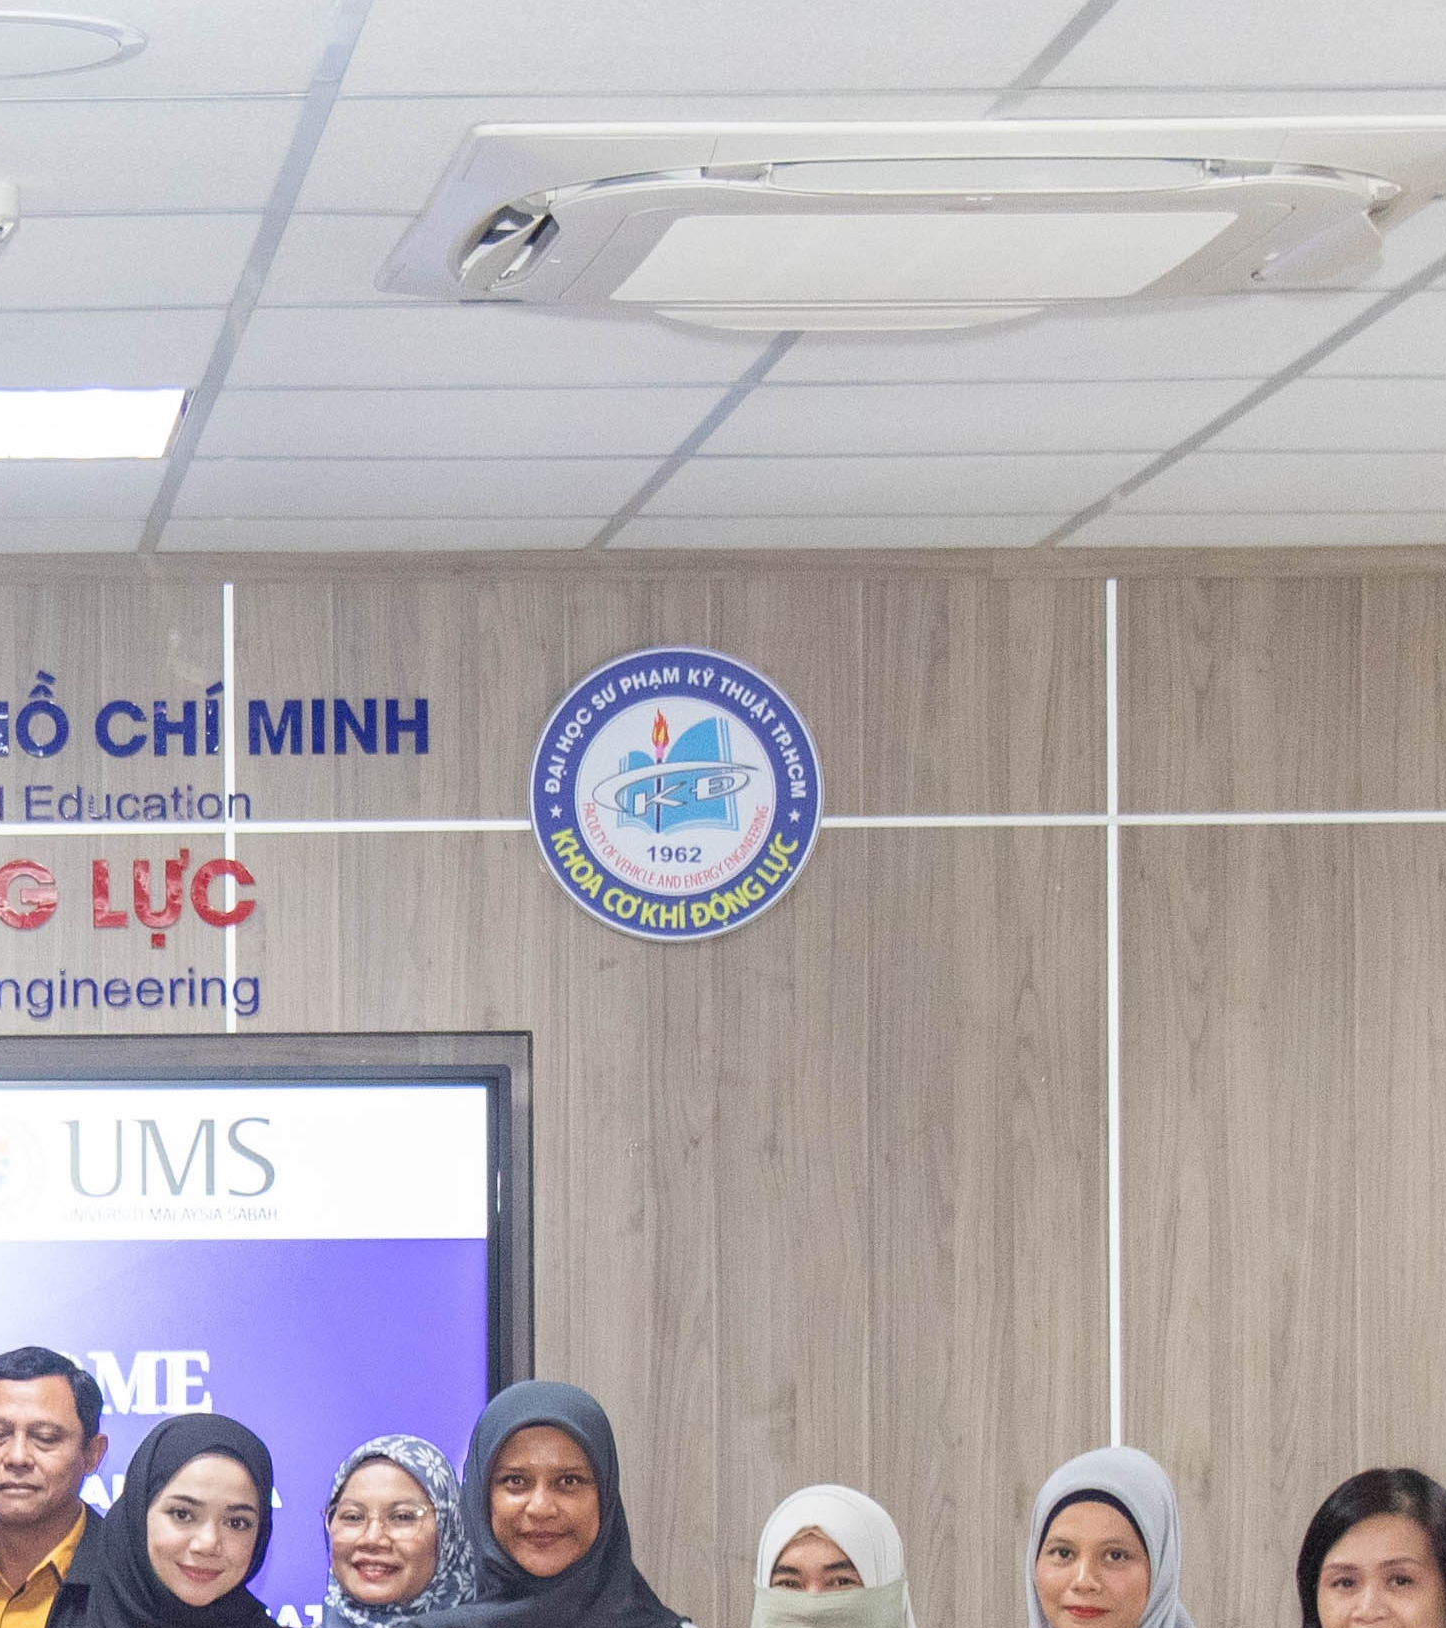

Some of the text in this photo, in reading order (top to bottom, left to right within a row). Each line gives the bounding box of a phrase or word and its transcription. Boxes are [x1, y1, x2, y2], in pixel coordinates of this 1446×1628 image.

[619, 667, 681, 697] PHẠM
[720, 676, 775, 725] THUẬT
[95, 680, 226, 757] CHÍ
[248, 698, 428, 756] MINH
[556, 706, 593, 753] HỌC
[544, 755, 569, 794] ĐẠI
[771, 720, 807, 800] TP.HCM
[24, 784, 252, 822] Education
[583, 802, 770, 889] FACULTY OF VEHICLE AND ENERGY ENGINEERING
[647, 846, 702, 863] 1962
[92, 847, 257, 949] LỰC
[550, 828, 605, 899] KHOA
[639, 902, 686, 930] KHÍ
[690, 877, 766, 927] ĐỘNG
[761, 831, 799, 887] LỰC
[61, 1116, 276, 1198] UMS
[227, 1207, 279, 1222] SABAH
